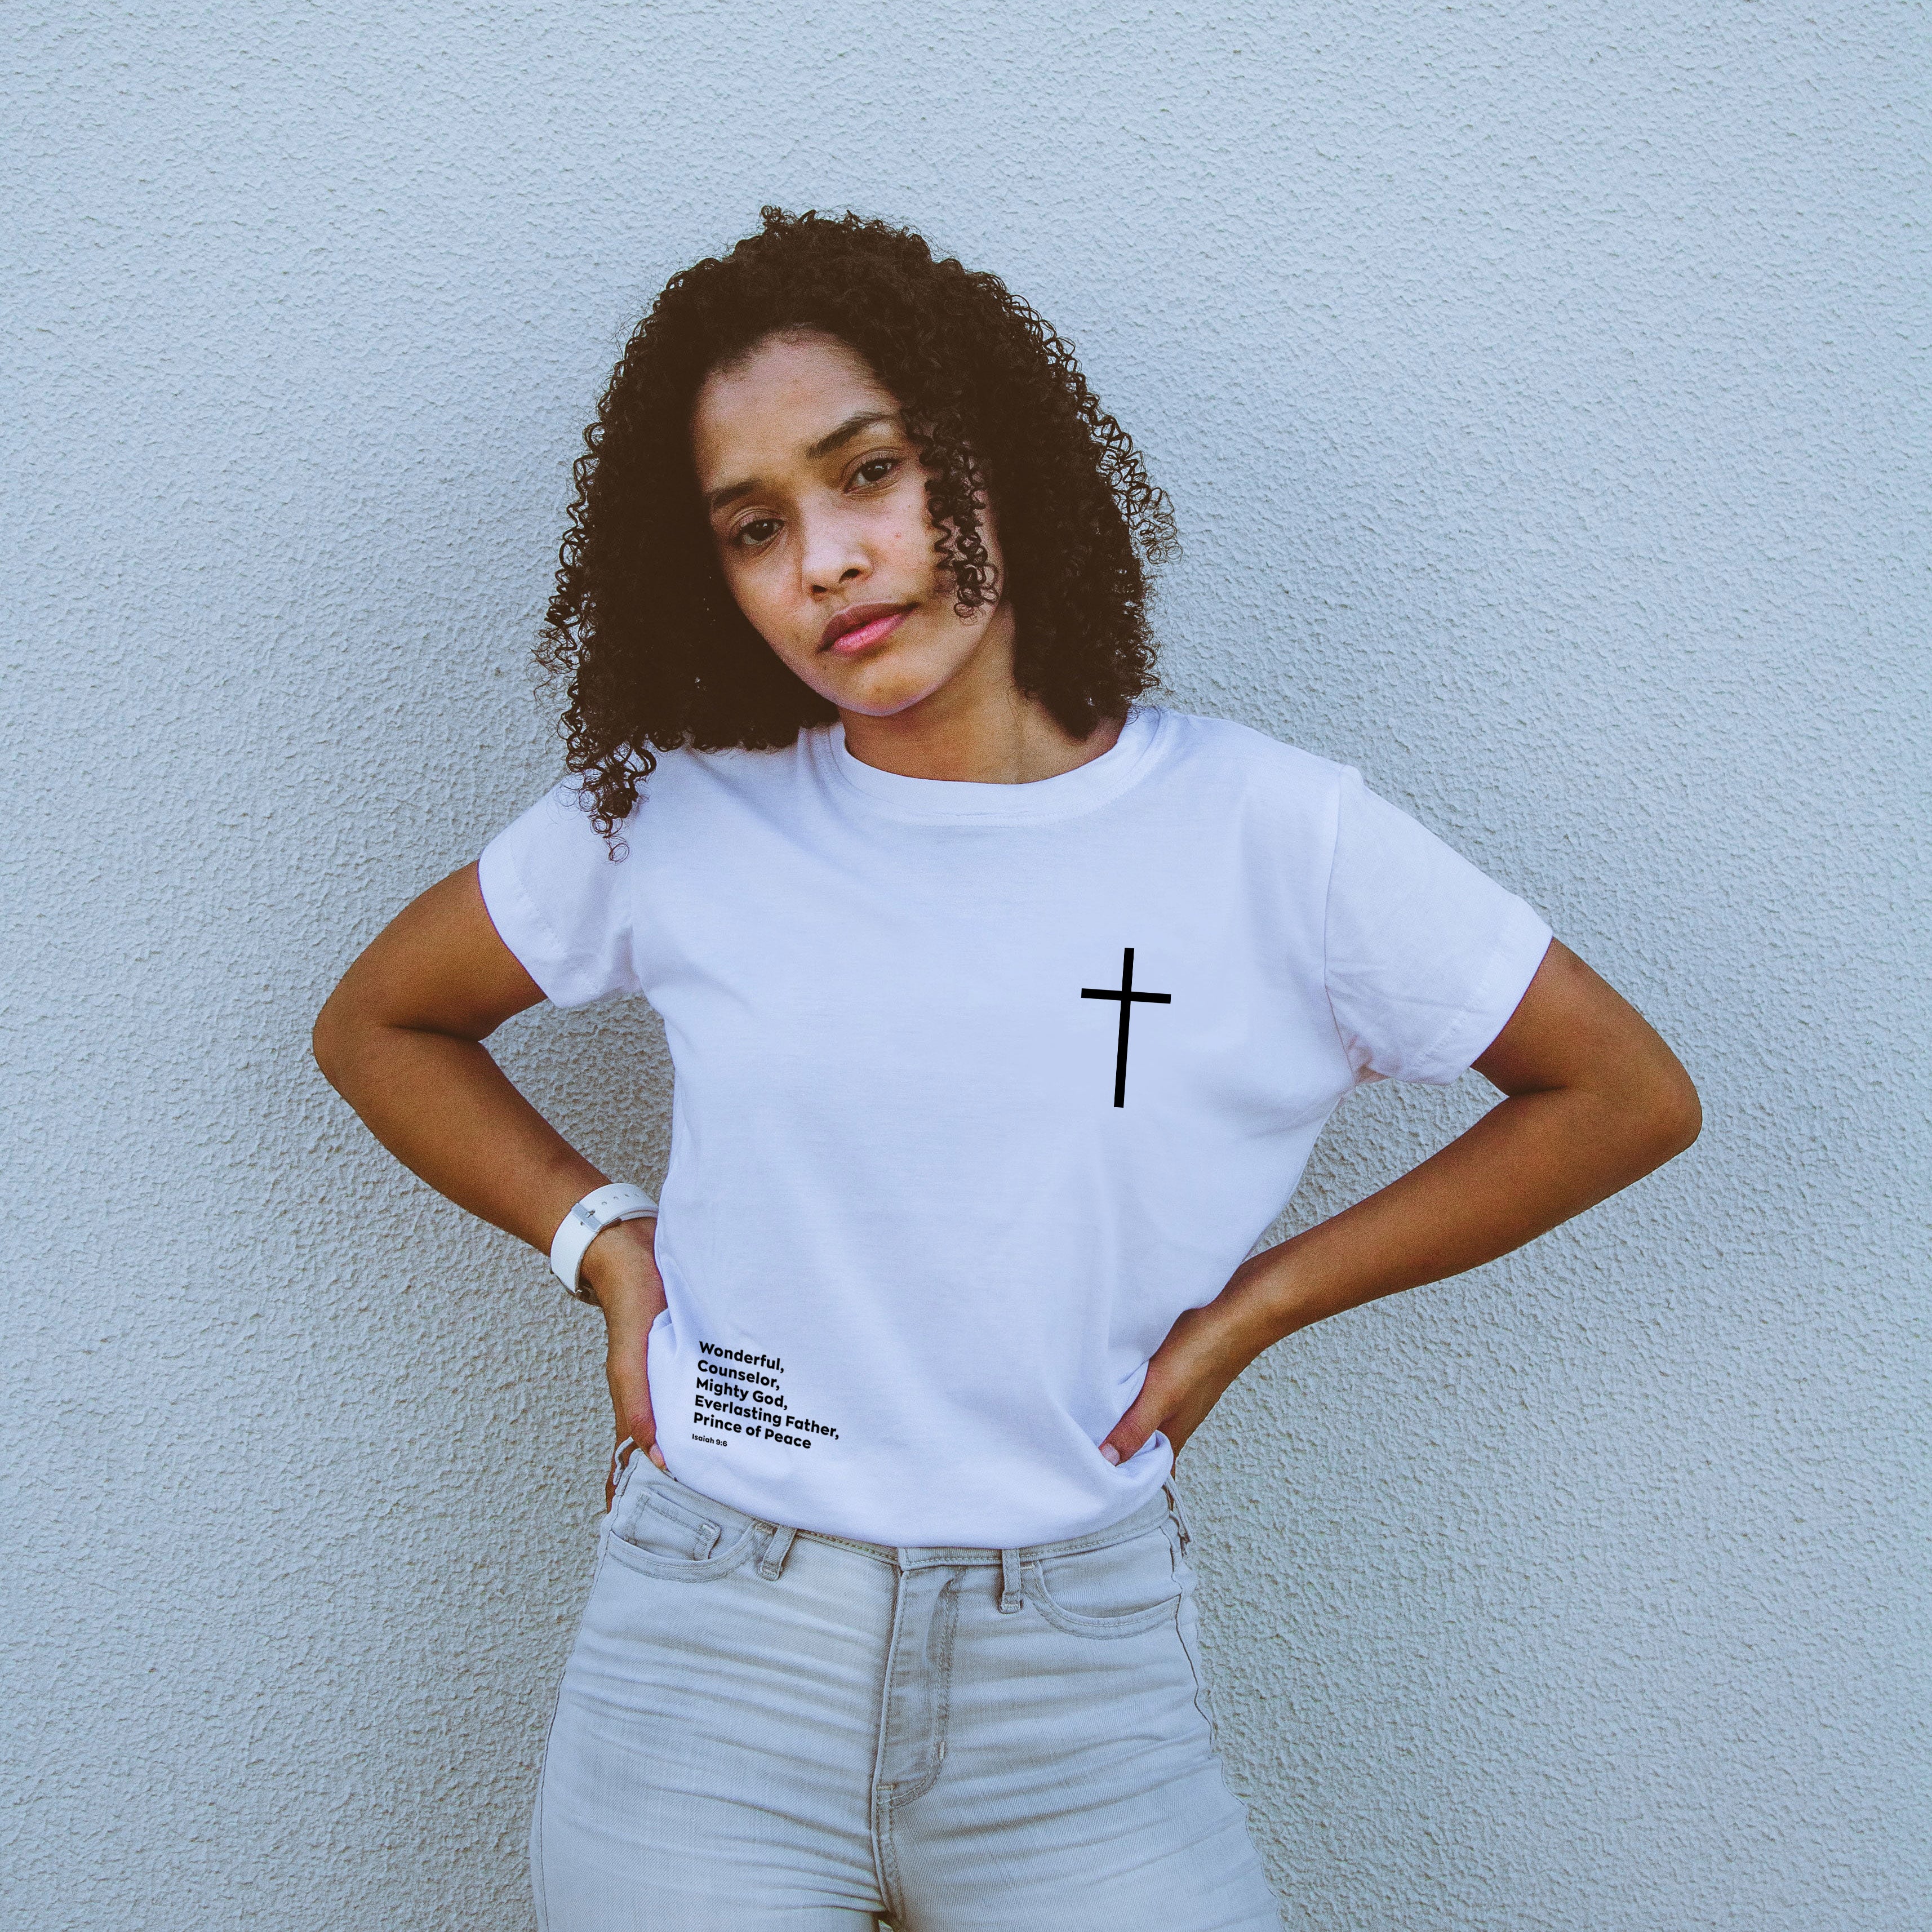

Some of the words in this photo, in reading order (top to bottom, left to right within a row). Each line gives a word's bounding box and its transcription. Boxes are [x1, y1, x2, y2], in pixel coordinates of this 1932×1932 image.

[699, 1341, 784, 1373] Wonderful,
[698, 1360, 779, 1391] Counselor,
[696, 1377, 749, 1401] Mighty
[753, 1391, 787, 1410] God,
[694, 1412, 741, 1433] Prince
[746, 1425, 761, 1437] of
[765, 1428, 811, 1449] Peace
[695, 1395, 781, 1427] Everlasting
[786, 1415, 838, 1440] Father,
[692, 1434, 714, 1444] Isaiah
